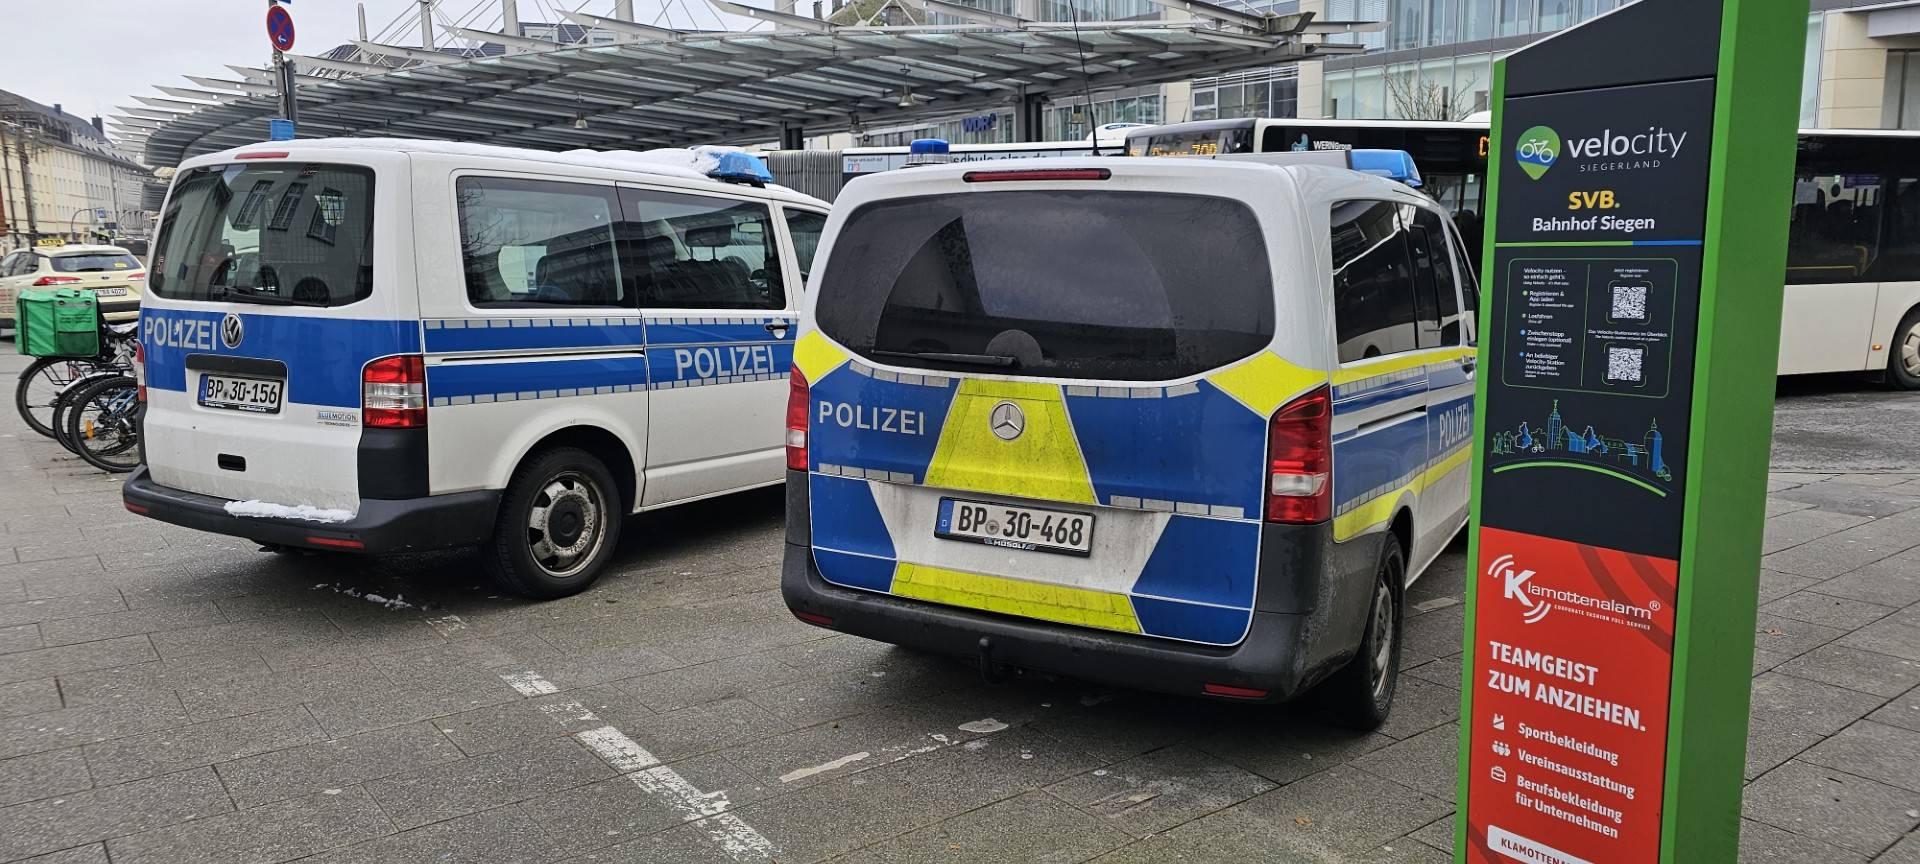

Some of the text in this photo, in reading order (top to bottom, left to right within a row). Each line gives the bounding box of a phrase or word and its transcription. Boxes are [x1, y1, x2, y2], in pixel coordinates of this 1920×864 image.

[963, 116, 989, 132] WDR
[1567, 127, 1687, 158] velocity
[1580, 160, 1661, 172] SIEGERLAND
[1568, 190, 1620, 210] SVB.
[1532, 215, 1656, 233] Bahnhof Siegen
[144, 317, 217, 351] POLIZEI
[674, 345, 775, 380] POLIZEI
[206, 378, 277, 404] BP 30-156
[818, 401, 925, 436] POLIZEI
[1439, 402, 1470, 451] POLIZEI
[958, 505, 1084, 547] BP 30-468
[1586, 611, 1610, 621] FASHION
[1611, 616, 1625, 625] FULL
[1489, 640, 1599, 686] TEAMGEIST
[1487, 669, 1646, 732] ZUM ANZIEHEN.
[1518, 722, 1619, 766] Sportbekleidung
[1518, 748, 1635, 800] Vereinsausstattung
[1515, 791, 1619, 839] für Unternehmen
[1516, 775, 1623, 824] Berufsbekleidung
